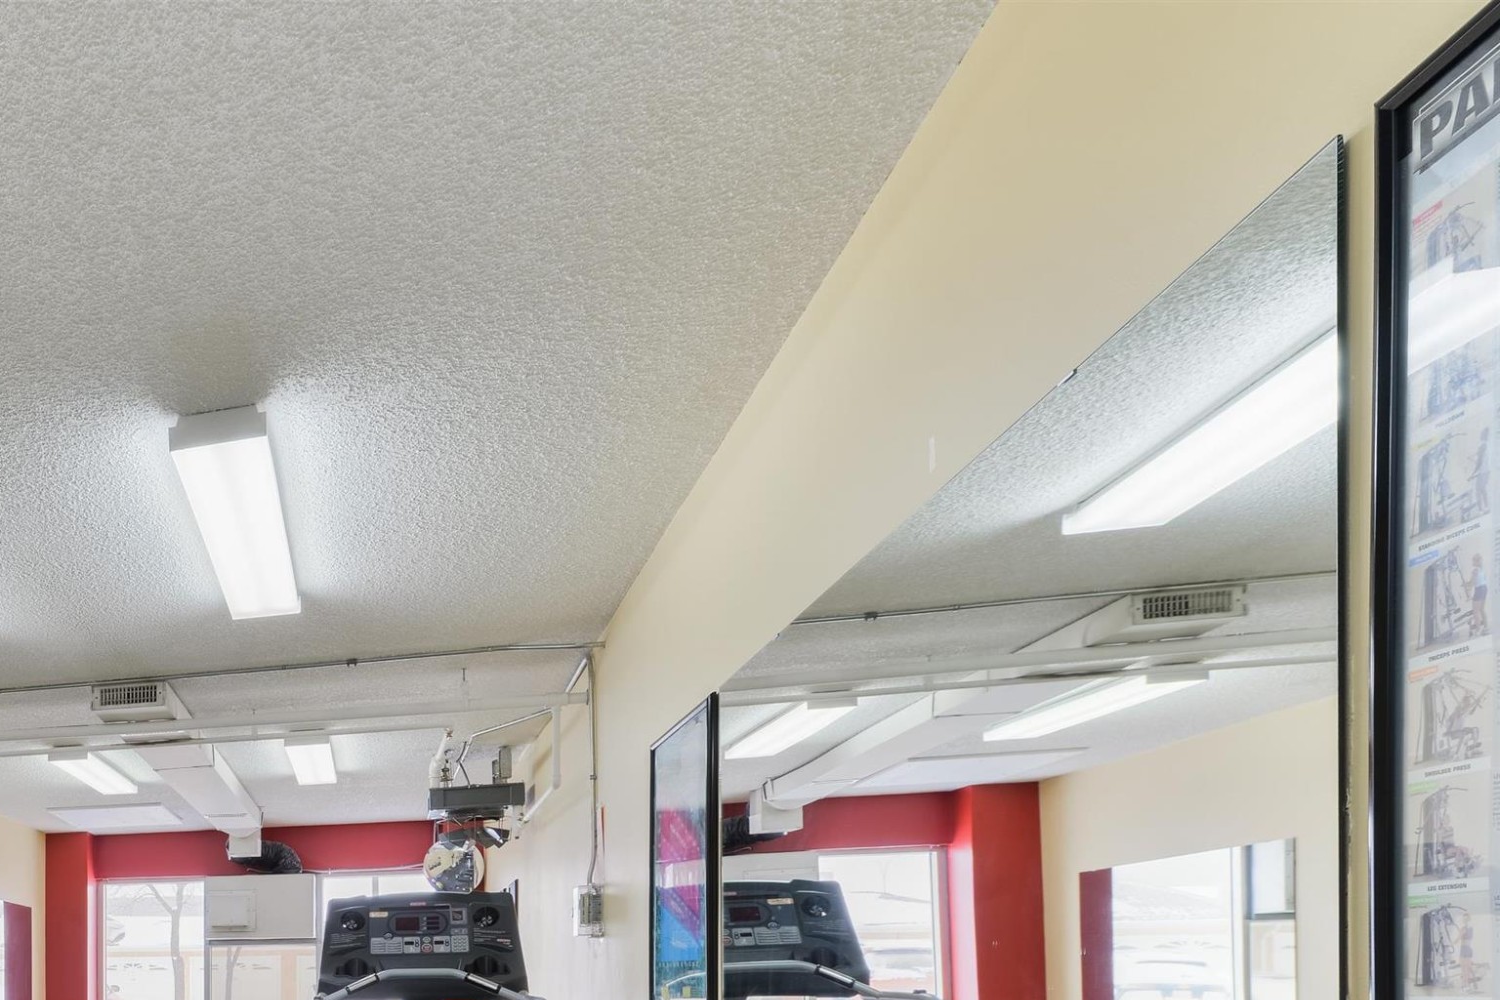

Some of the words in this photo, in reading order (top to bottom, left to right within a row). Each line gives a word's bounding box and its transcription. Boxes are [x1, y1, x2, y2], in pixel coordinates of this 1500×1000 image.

[1420, 58, 1500, 161] PA
[1451, 645, 1469, 655] PRESS
[1438, 882, 1468, 891] EXTENSION
